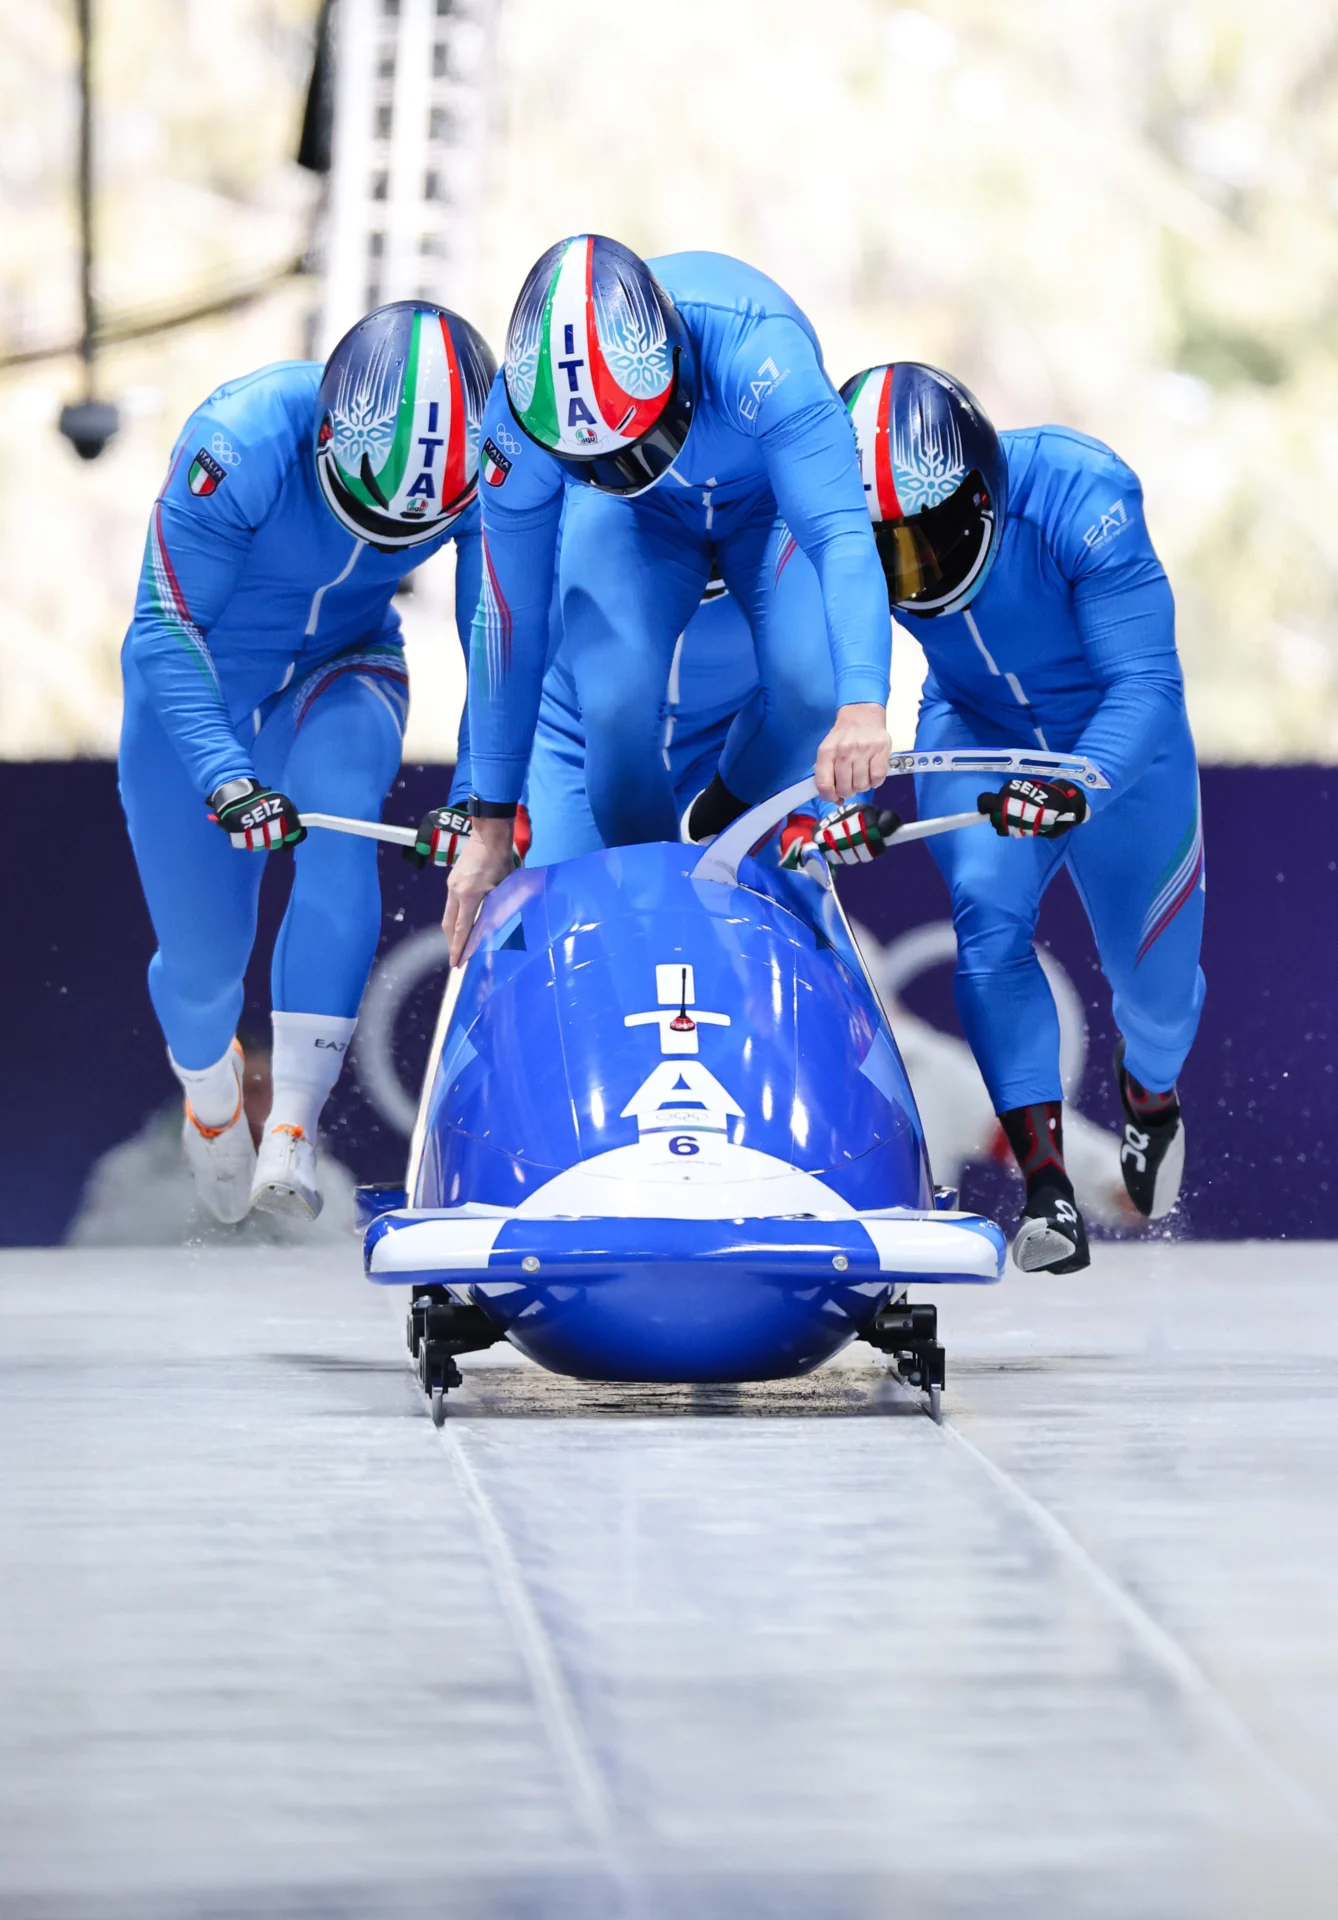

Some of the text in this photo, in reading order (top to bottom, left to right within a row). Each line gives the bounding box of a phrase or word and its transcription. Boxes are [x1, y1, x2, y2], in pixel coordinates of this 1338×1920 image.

[558, 324, 597, 427] ITA
[740, 356, 780, 420] EA7
[199, 450, 223, 478] ITALIA
[406, 402, 444, 498] ITA
[486, 440, 510, 469] ITALIA
[1083, 499, 1127, 548] EA7
[1009, 779, 1049, 805] SEIZ
[241, 798, 284, 830] SEIZ
[438, 811, 472, 835] SEI
[314, 1038, 348, 1052] EA7
[620, 964, 746, 1117] ITA
[668, 1135, 700, 1156] 6
